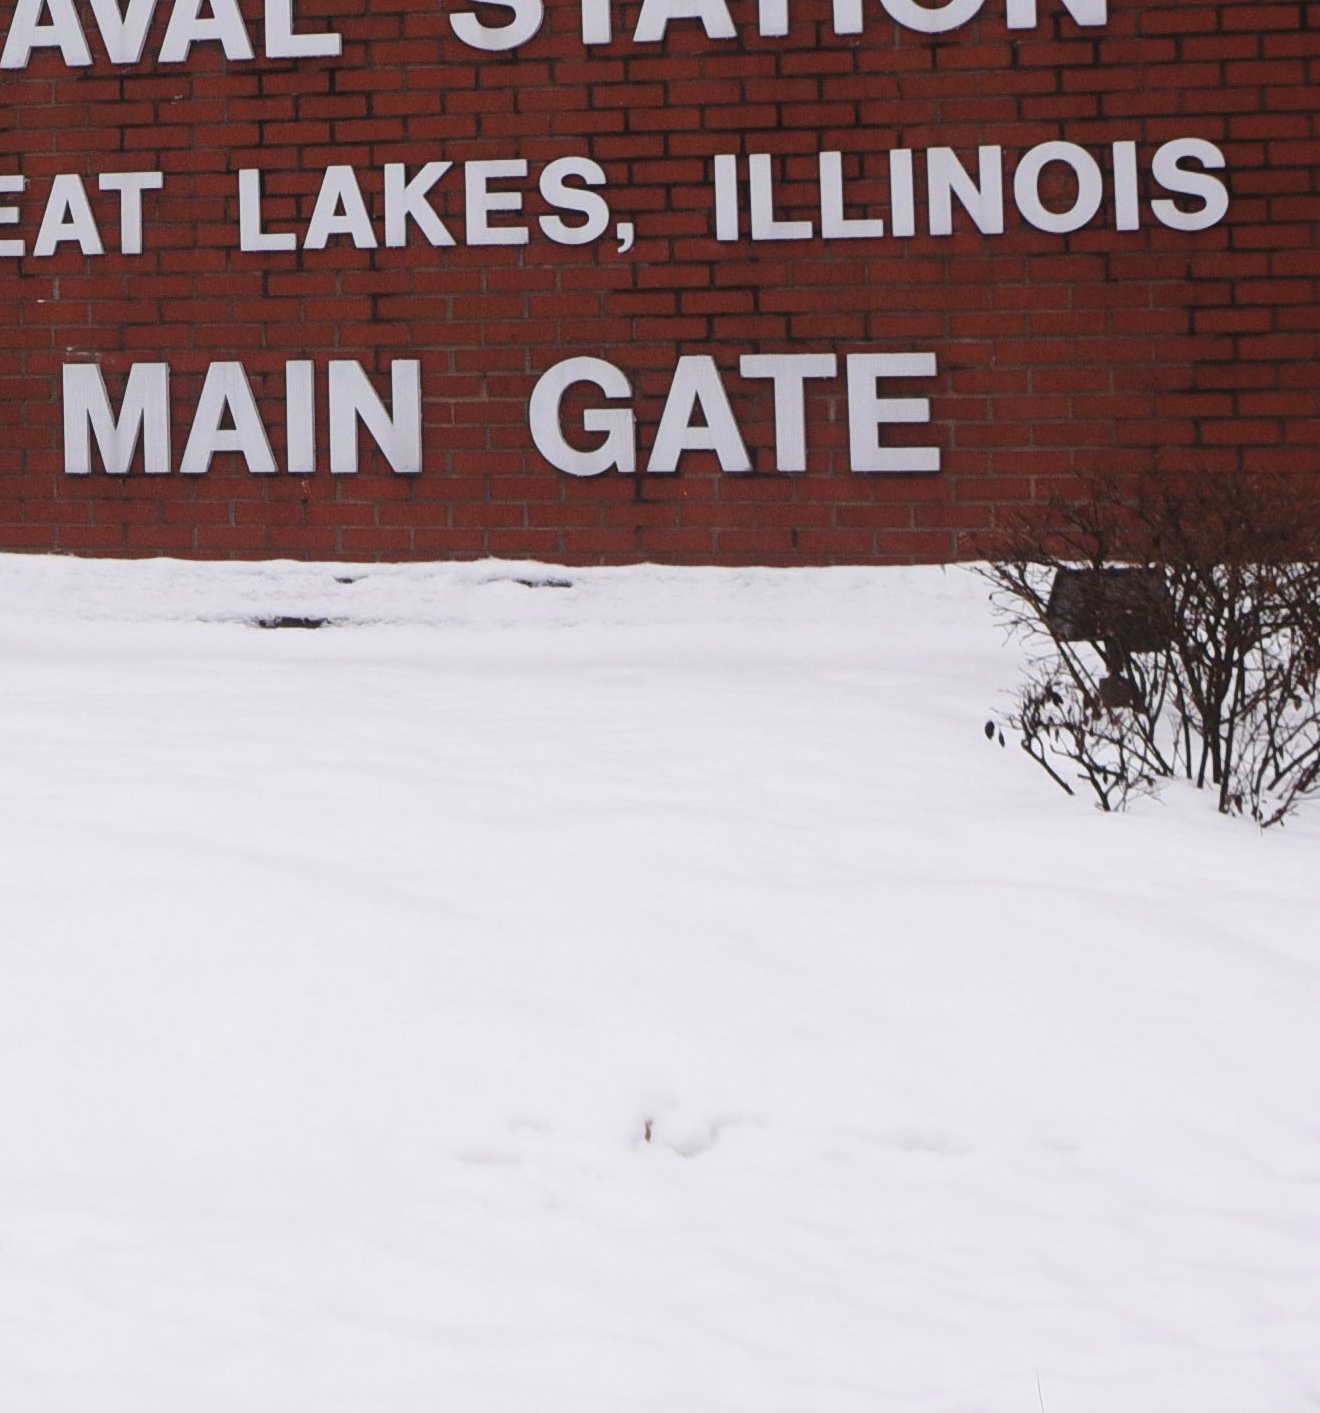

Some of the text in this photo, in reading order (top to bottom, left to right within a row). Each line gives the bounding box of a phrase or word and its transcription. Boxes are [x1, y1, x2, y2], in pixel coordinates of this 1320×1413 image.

[238, 156, 634, 253] LAKES,
[714, 137, 1229, 241] ILLINOIS
[62, 352, 941, 477] MAIN GATE
